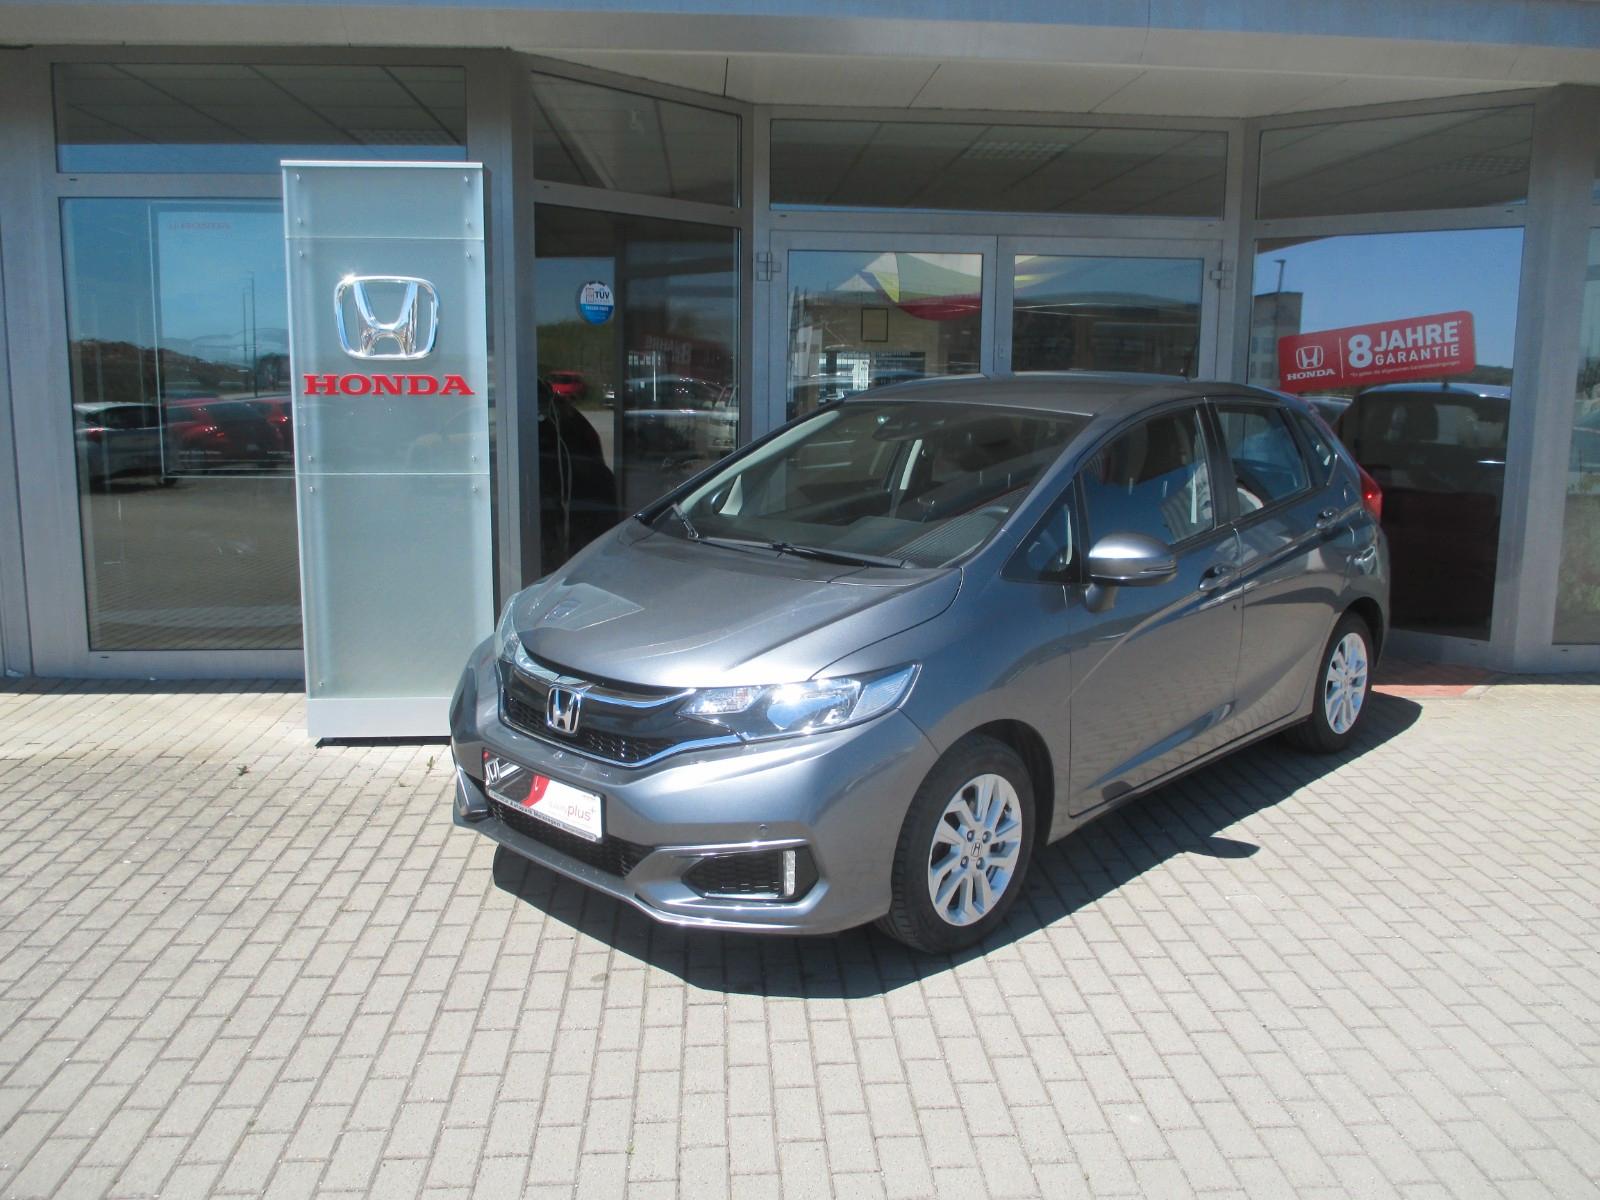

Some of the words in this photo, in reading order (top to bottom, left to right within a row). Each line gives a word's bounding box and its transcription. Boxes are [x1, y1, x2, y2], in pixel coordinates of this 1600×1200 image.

[1348, 334, 1373, 368] 8
[1375, 344, 1460, 365] GARANTIE
[1286, 367, 1336, 381] HONDA
[303, 374, 475, 396] HONDA
